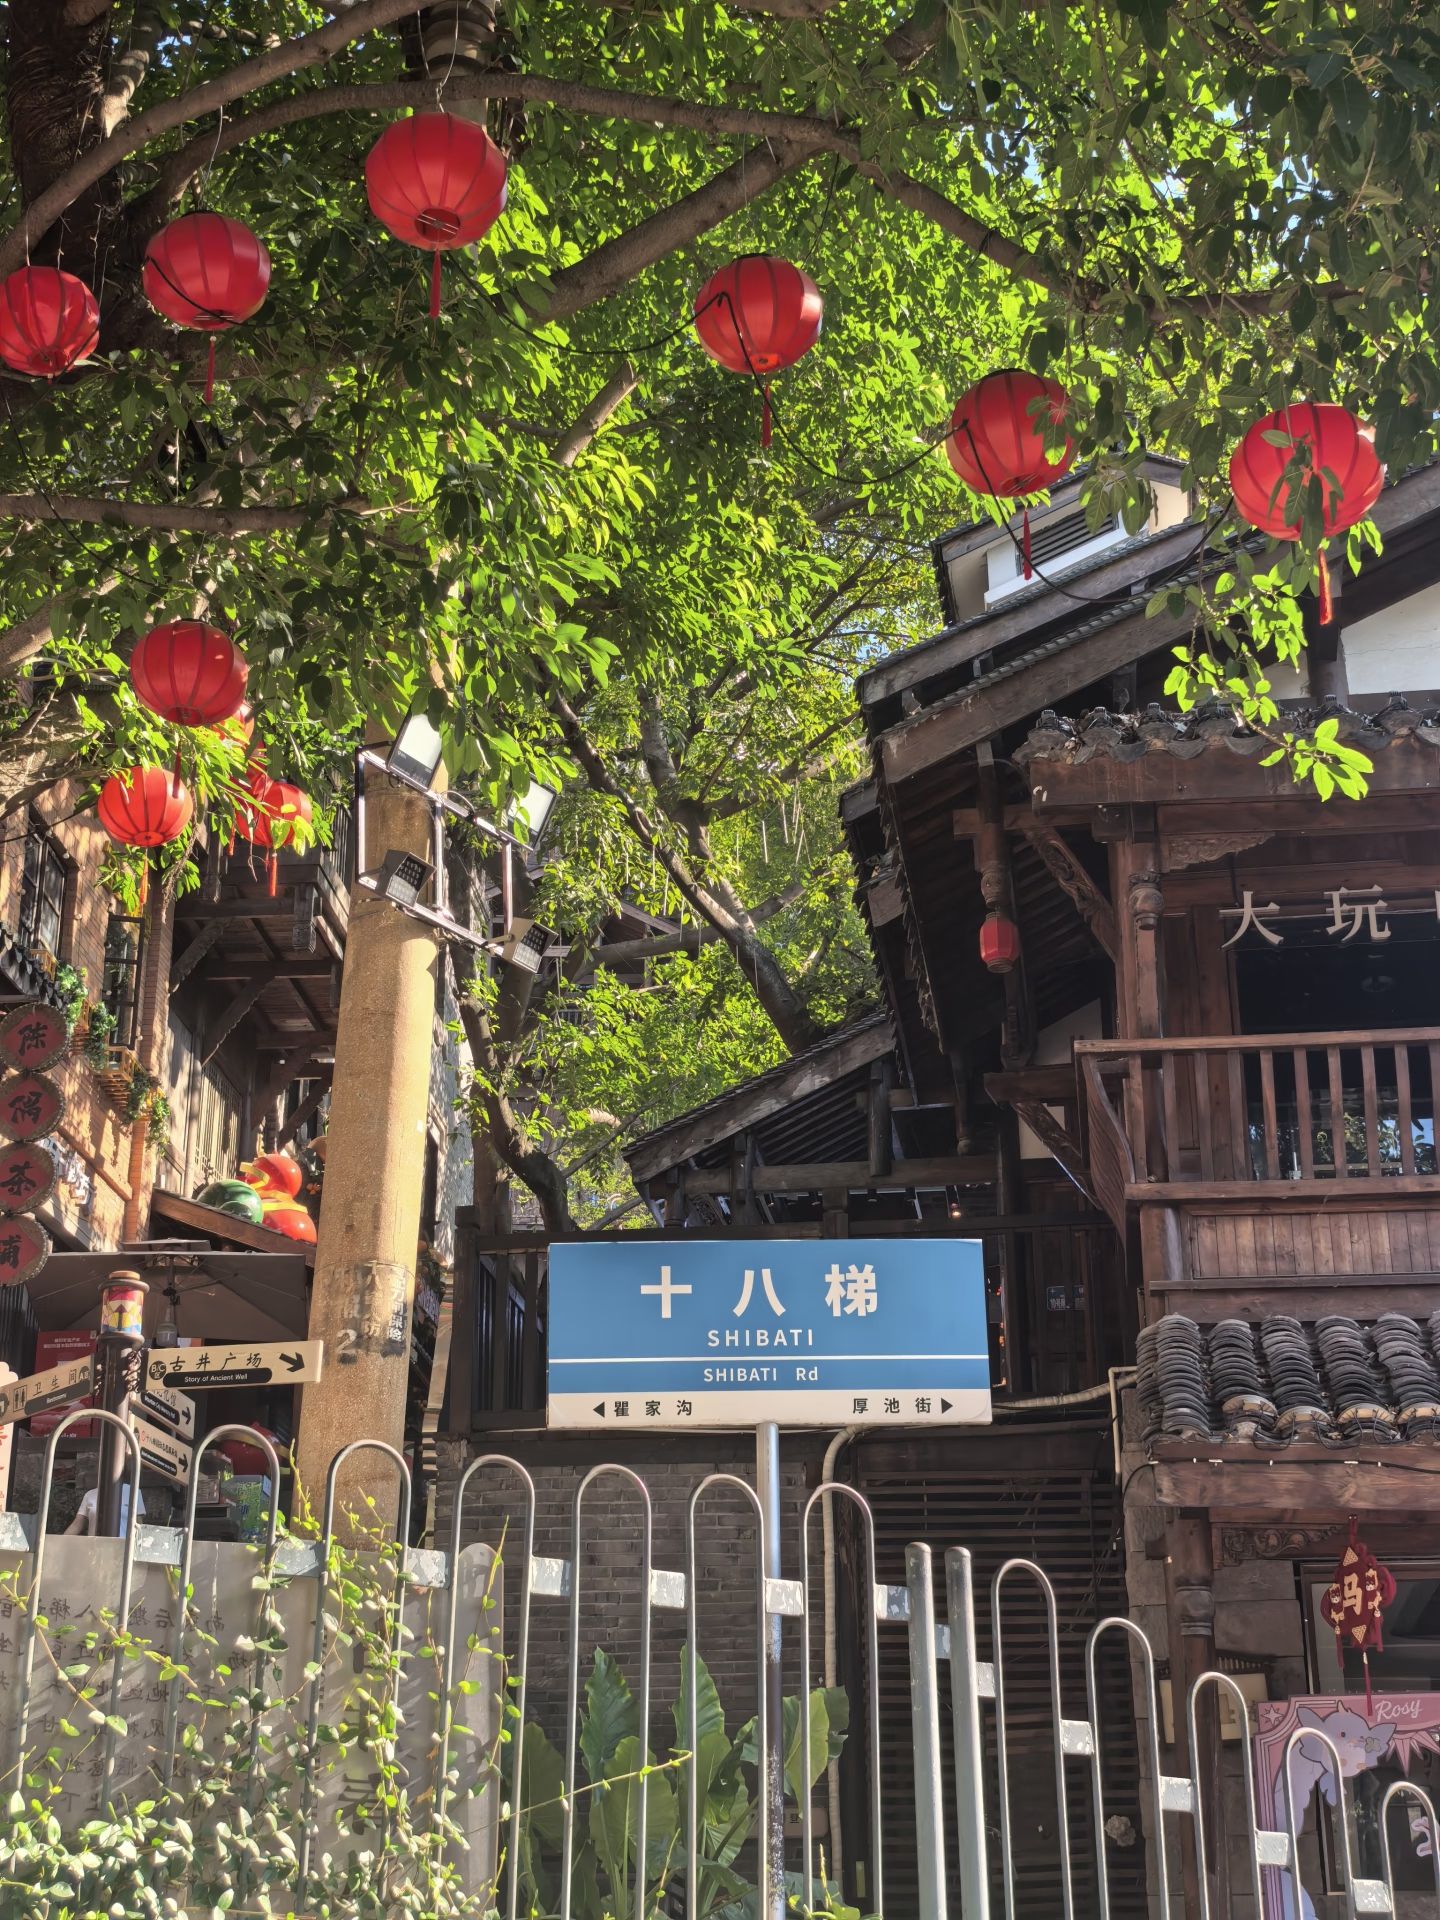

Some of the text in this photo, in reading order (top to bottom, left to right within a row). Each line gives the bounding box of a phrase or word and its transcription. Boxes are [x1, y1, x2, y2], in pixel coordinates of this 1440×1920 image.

[1219, 884, 1440, 948] 大玩
[640, 1264, 878, 1320] 十八梯
[707, 1328, 814, 1348] SHIBATI
[169, 1352, 262, 1372] 古井广场
[33, 1368, 77, 1397] 卫生间
[184, 1376, 200, 1384] Story
[703, 1366, 819, 1383] SHIBATI Rd
[613, 1399, 692, 1417] 瞿家沟
[852, 1397, 932, 1414] 厚池街
[1343, 1573, 1363, 1616] 马
[1375, 1700, 1423, 1723] Rosy
